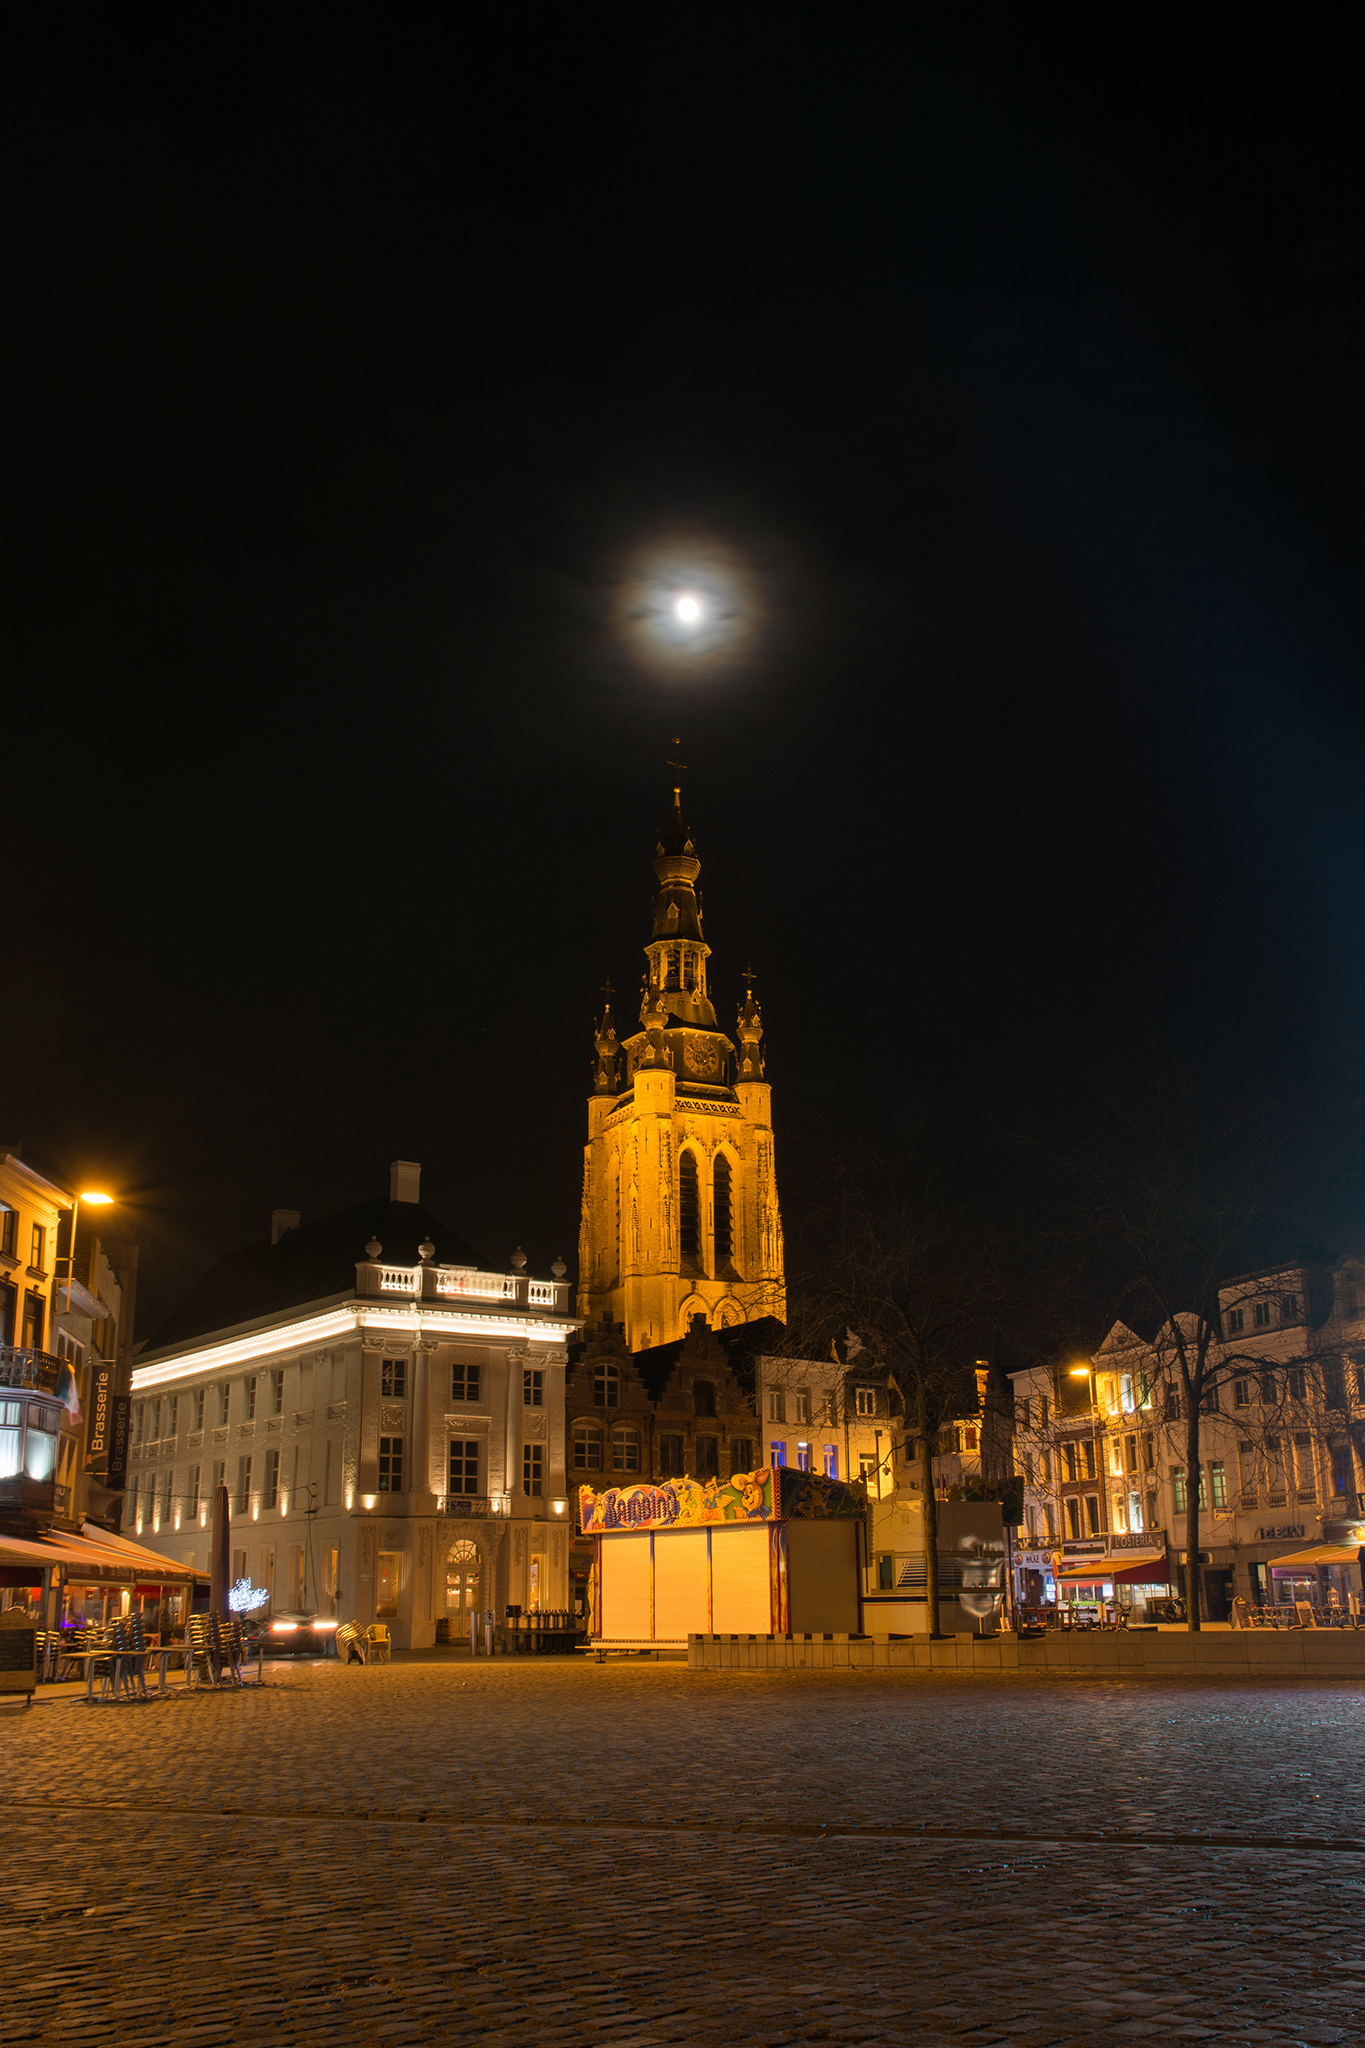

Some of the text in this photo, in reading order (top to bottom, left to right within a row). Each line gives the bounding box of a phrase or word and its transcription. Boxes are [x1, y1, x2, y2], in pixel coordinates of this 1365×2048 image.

[91, 1372, 109, 1451] Brasserie
[111, 1402, 127, 1472] Brasserie
[1115, 1535, 1154, 1548] L'OSTERIA
